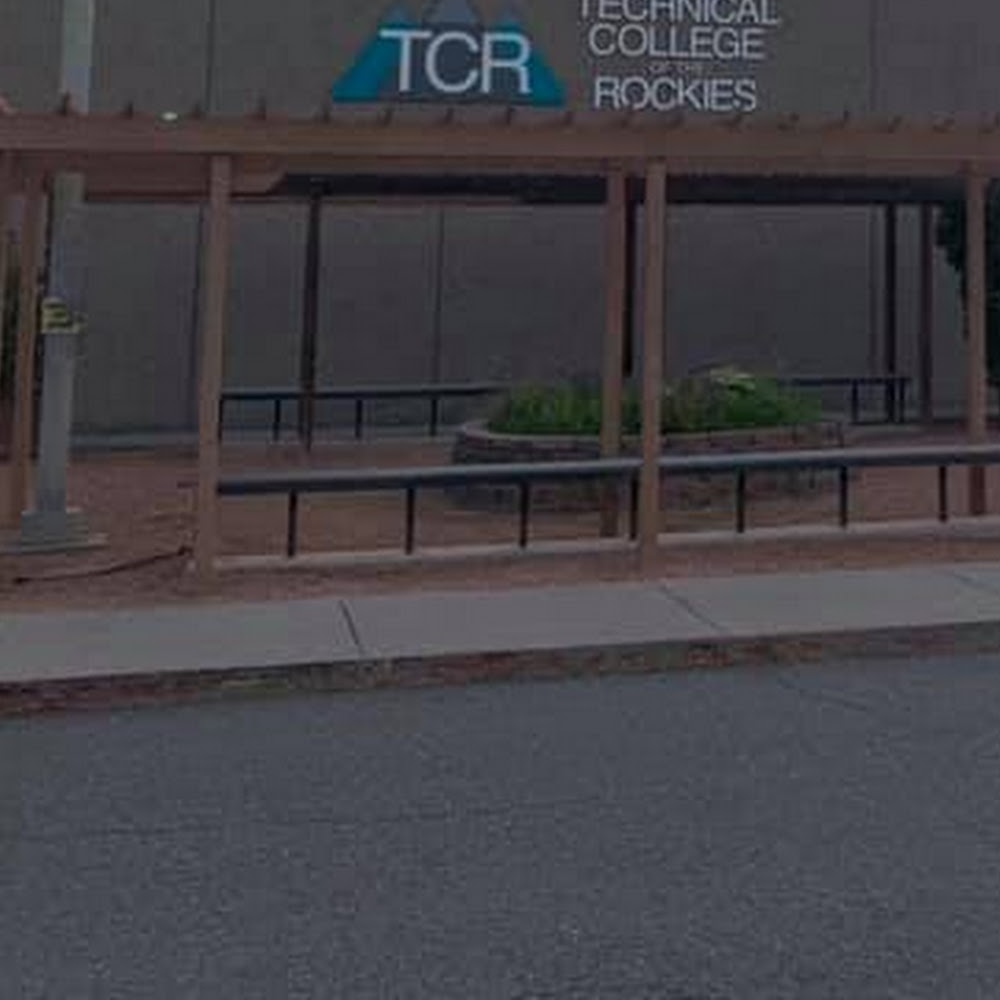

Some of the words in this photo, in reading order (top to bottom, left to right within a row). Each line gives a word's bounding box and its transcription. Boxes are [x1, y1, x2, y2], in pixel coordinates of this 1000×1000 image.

[588, 23, 766, 59] COLLEGE
[379, 28, 532, 94] TCR
[593, 74, 757, 111] ROCKIES
